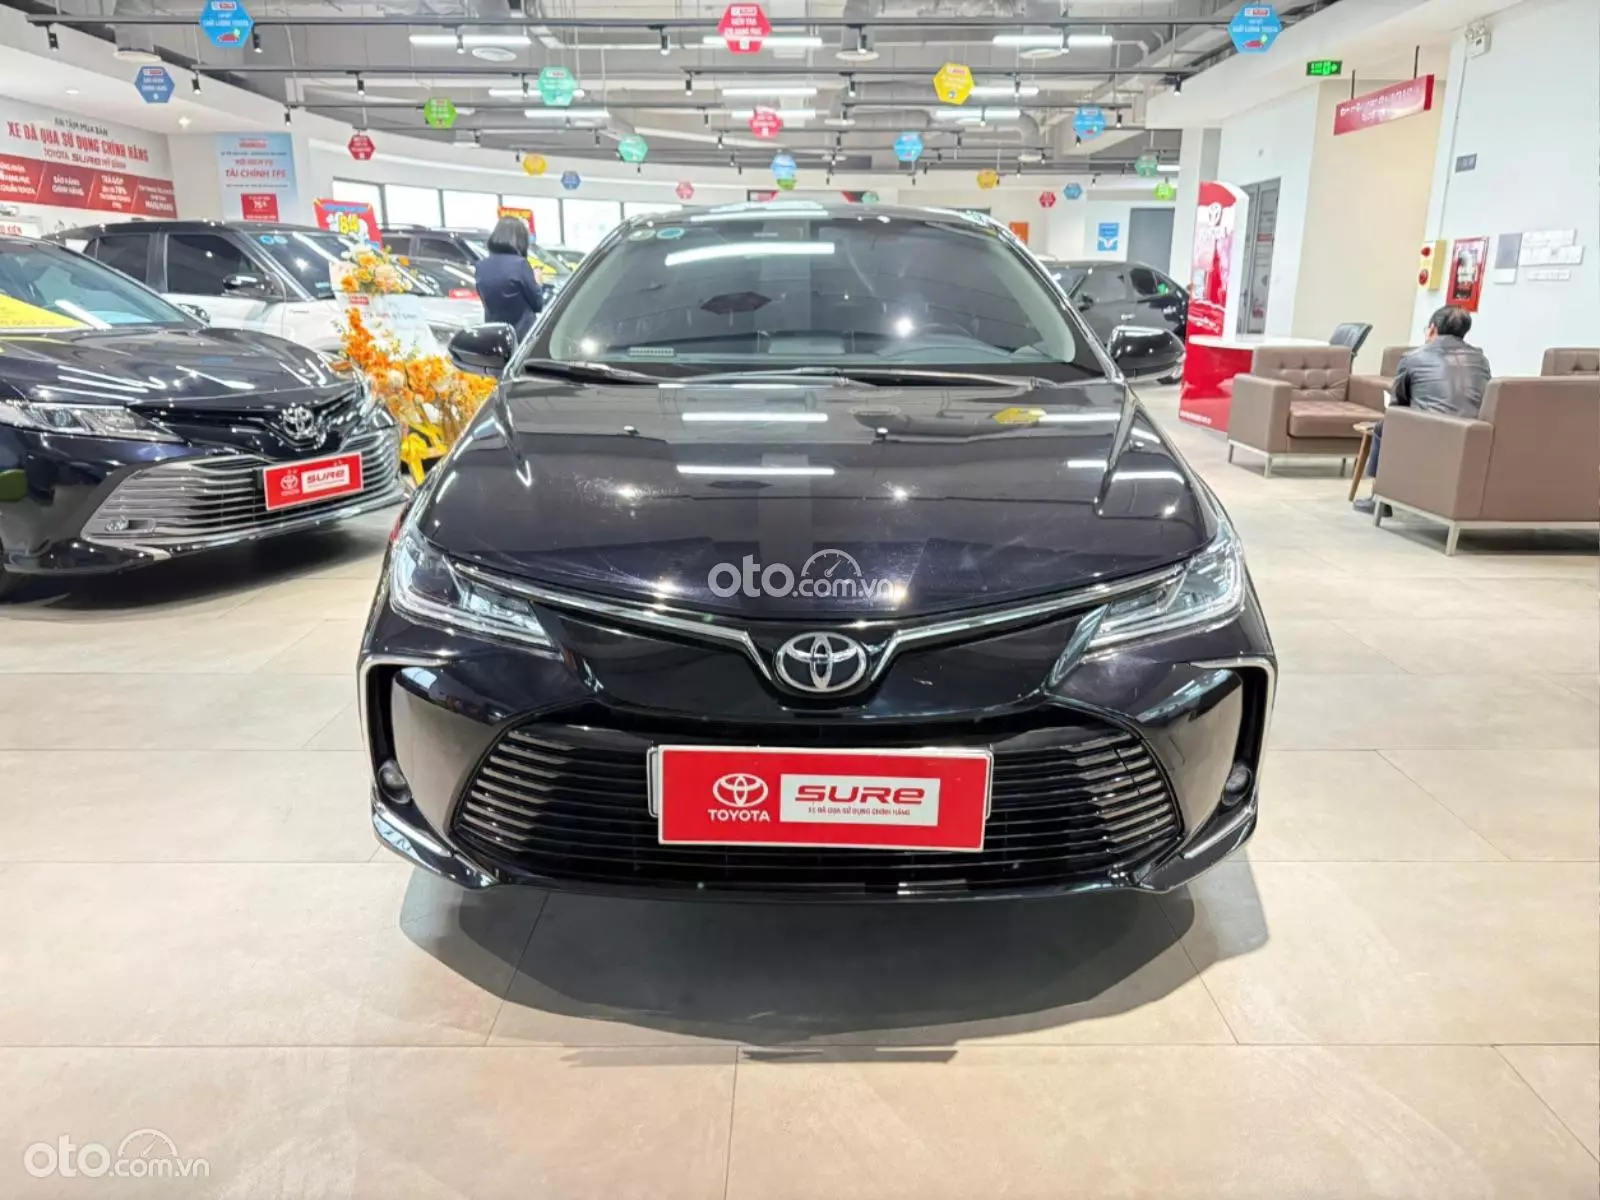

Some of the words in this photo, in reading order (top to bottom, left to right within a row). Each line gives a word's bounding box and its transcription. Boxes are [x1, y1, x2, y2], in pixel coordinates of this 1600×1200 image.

[7, 121, 21, 138] XE
[40, 127, 60, 145] QUA
[306, 469, 345, 484] SURE
[794, 784, 926, 805] SURE
[707, 808, 771, 824] TOYOTA
